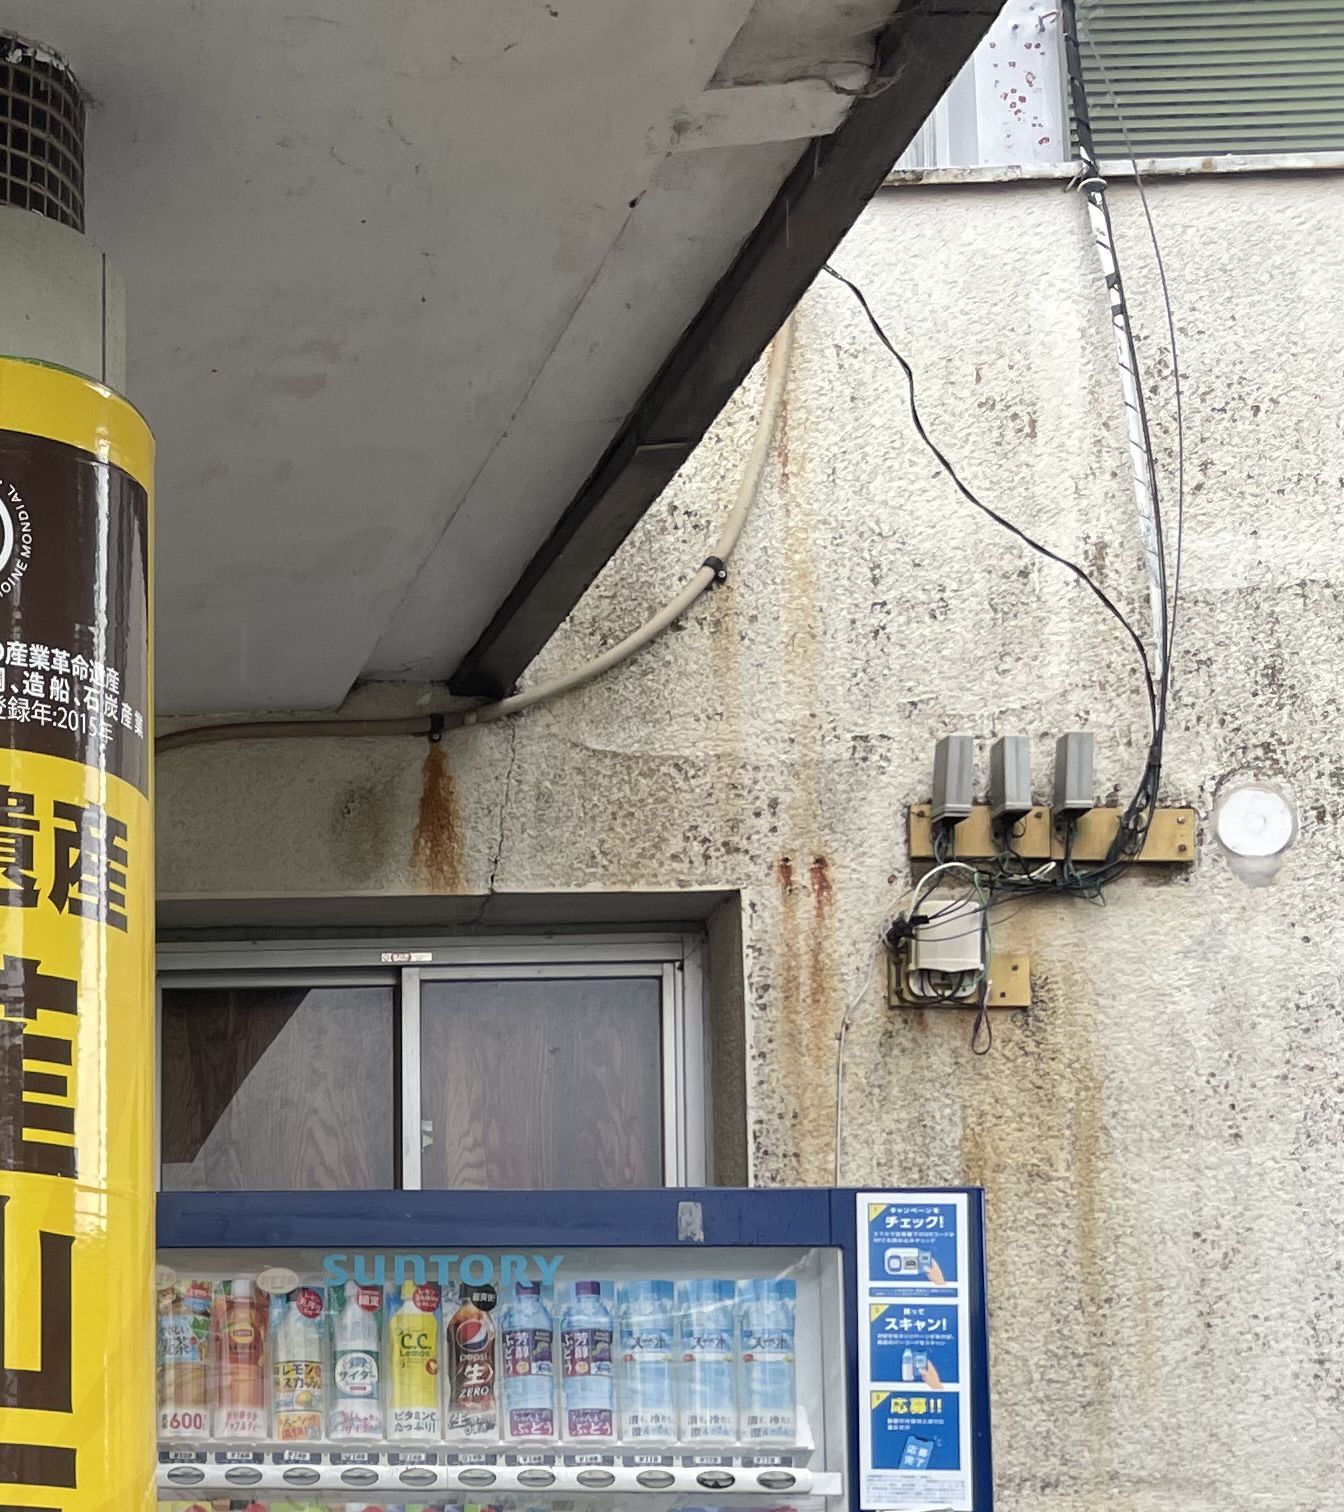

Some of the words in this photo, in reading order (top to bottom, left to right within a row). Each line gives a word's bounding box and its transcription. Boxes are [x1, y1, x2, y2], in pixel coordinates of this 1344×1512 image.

[4, 483, 34, 558] MONDIAL
[885, 1216, 945, 1230] チェック!
[322, 1253, 566, 1288] SUNTORY
[885, 1317, 947, 1332] スキャン!
[400, 1333, 433, 1350] C.C.
[463, 1363, 484, 1385] 生
[459, 1386, 490, 1398] ZERO
[169, 1412, 203, 1430] 600
